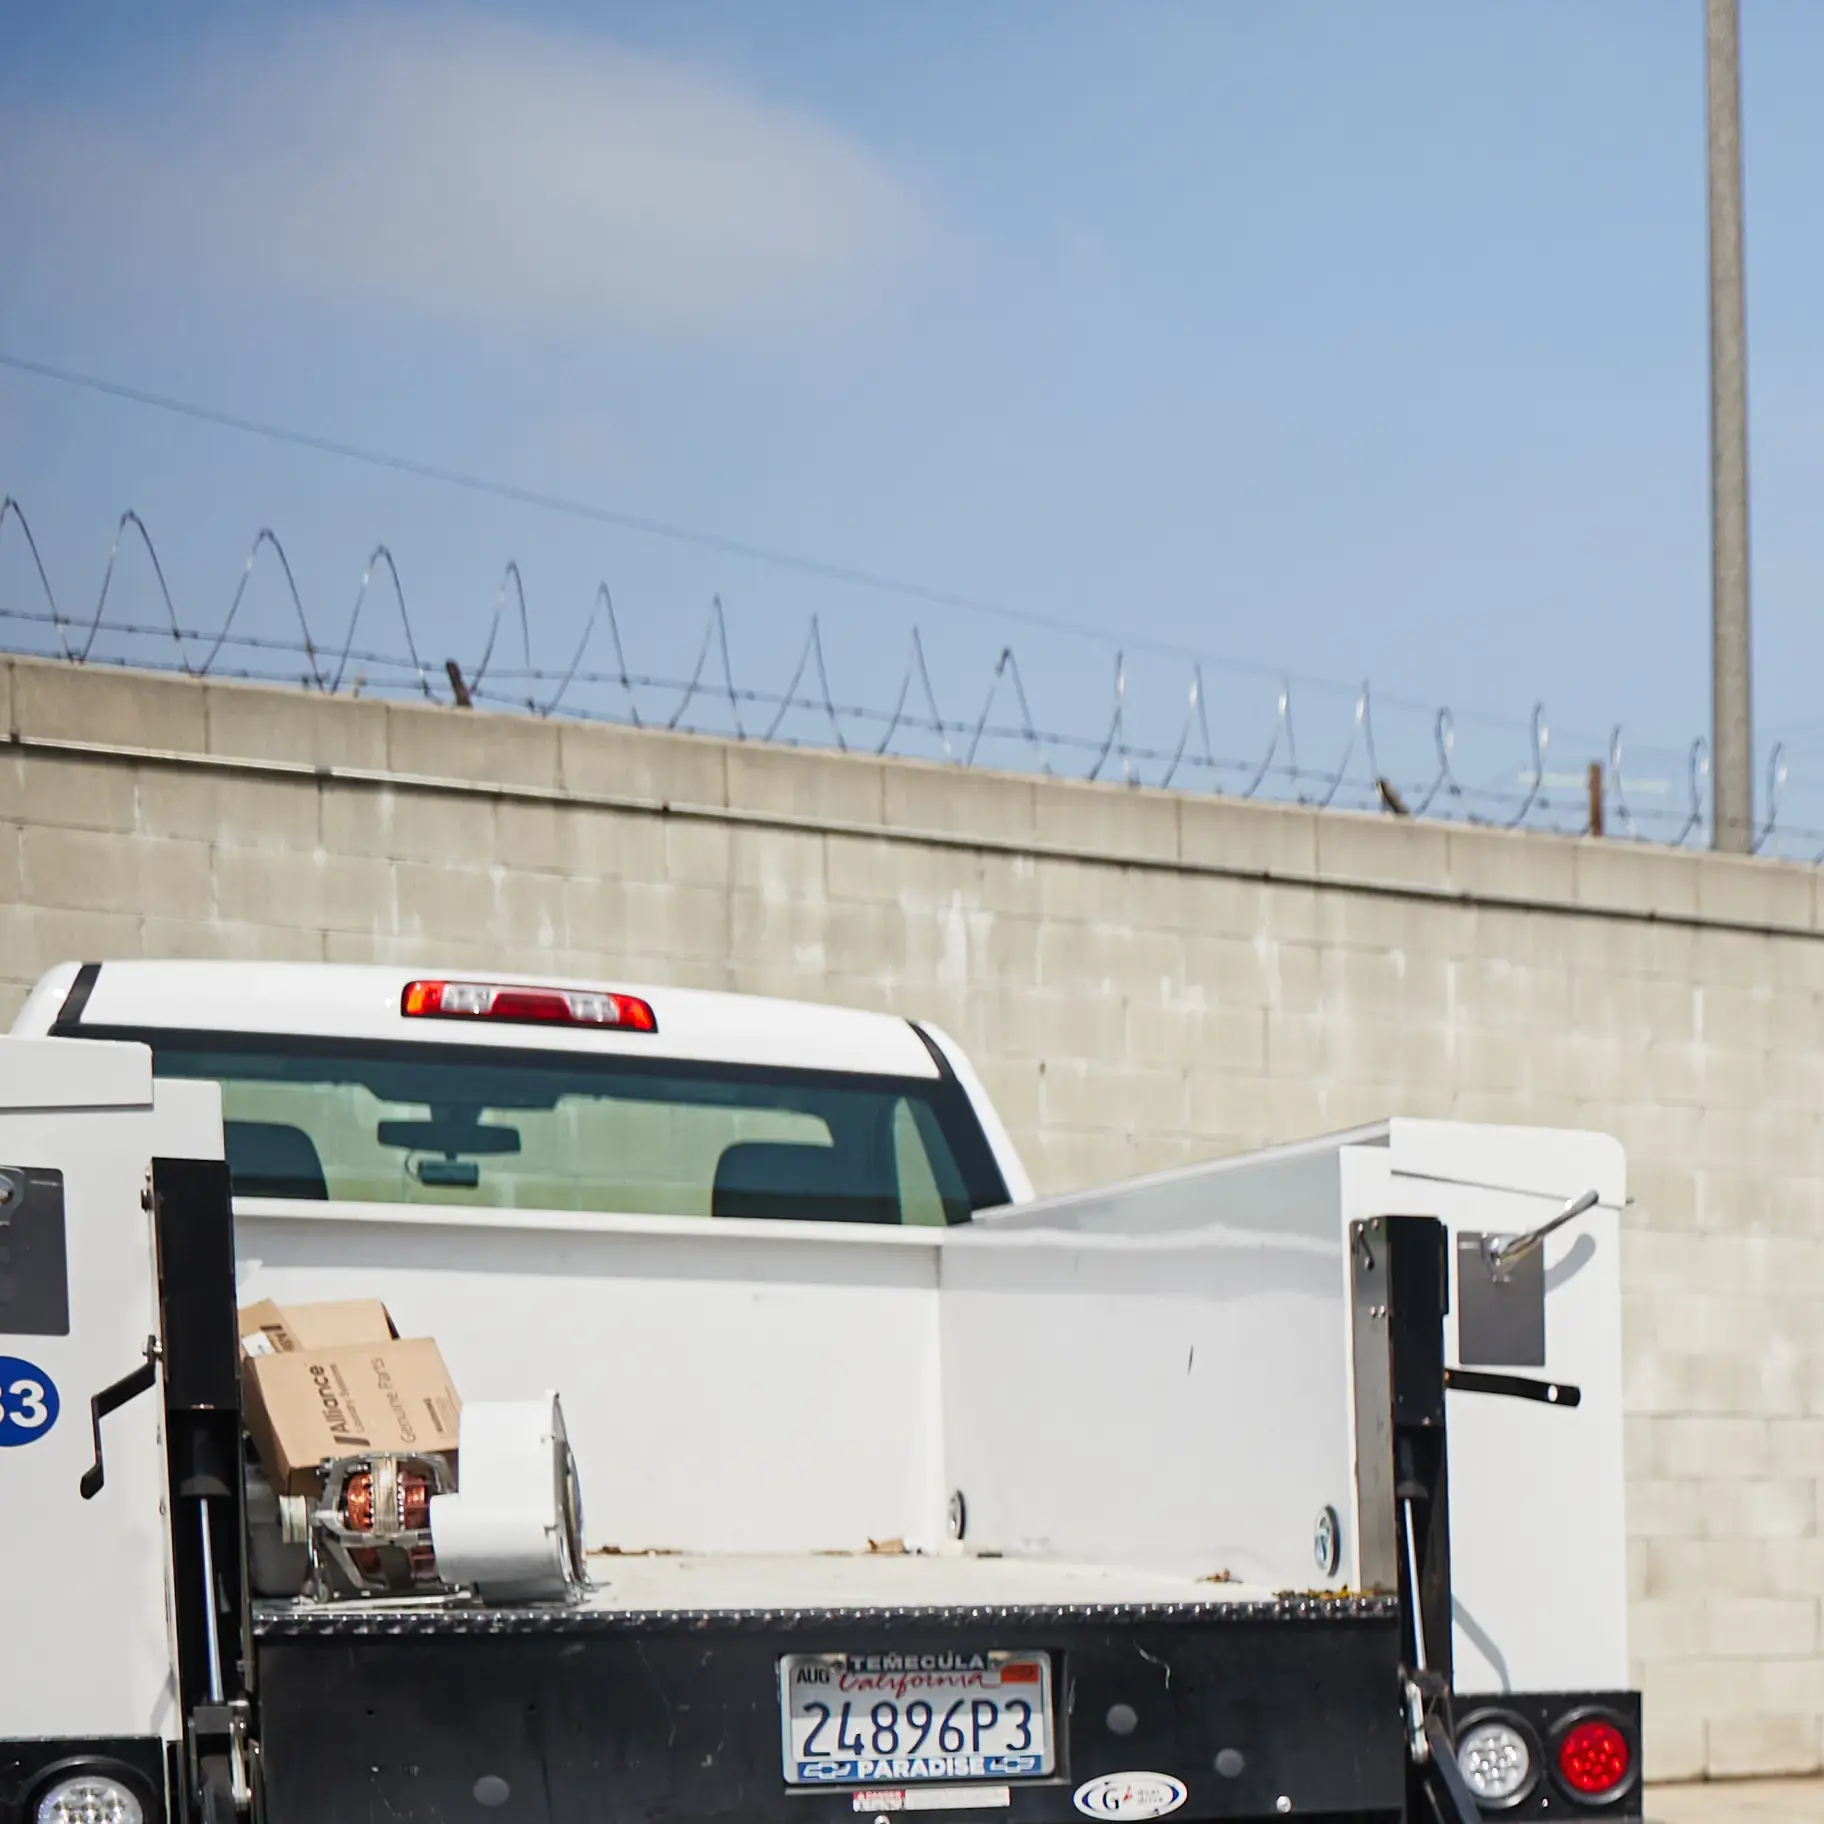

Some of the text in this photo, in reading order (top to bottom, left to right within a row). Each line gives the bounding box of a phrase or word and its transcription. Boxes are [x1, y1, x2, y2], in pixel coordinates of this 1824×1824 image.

[0, 1379, 48, 1428] 3
[309, 1364, 349, 1434] Alliance
[370, 1356, 417, 1444] Genuine Parts
[796, 1666, 831, 1684] AUG
[850, 1655, 988, 1672] TEMECULA
[838, 1673, 1000, 1699] California
[802, 1700, 1033, 1757] 24896P3
[857, 1755, 986, 1779] PARADISE
